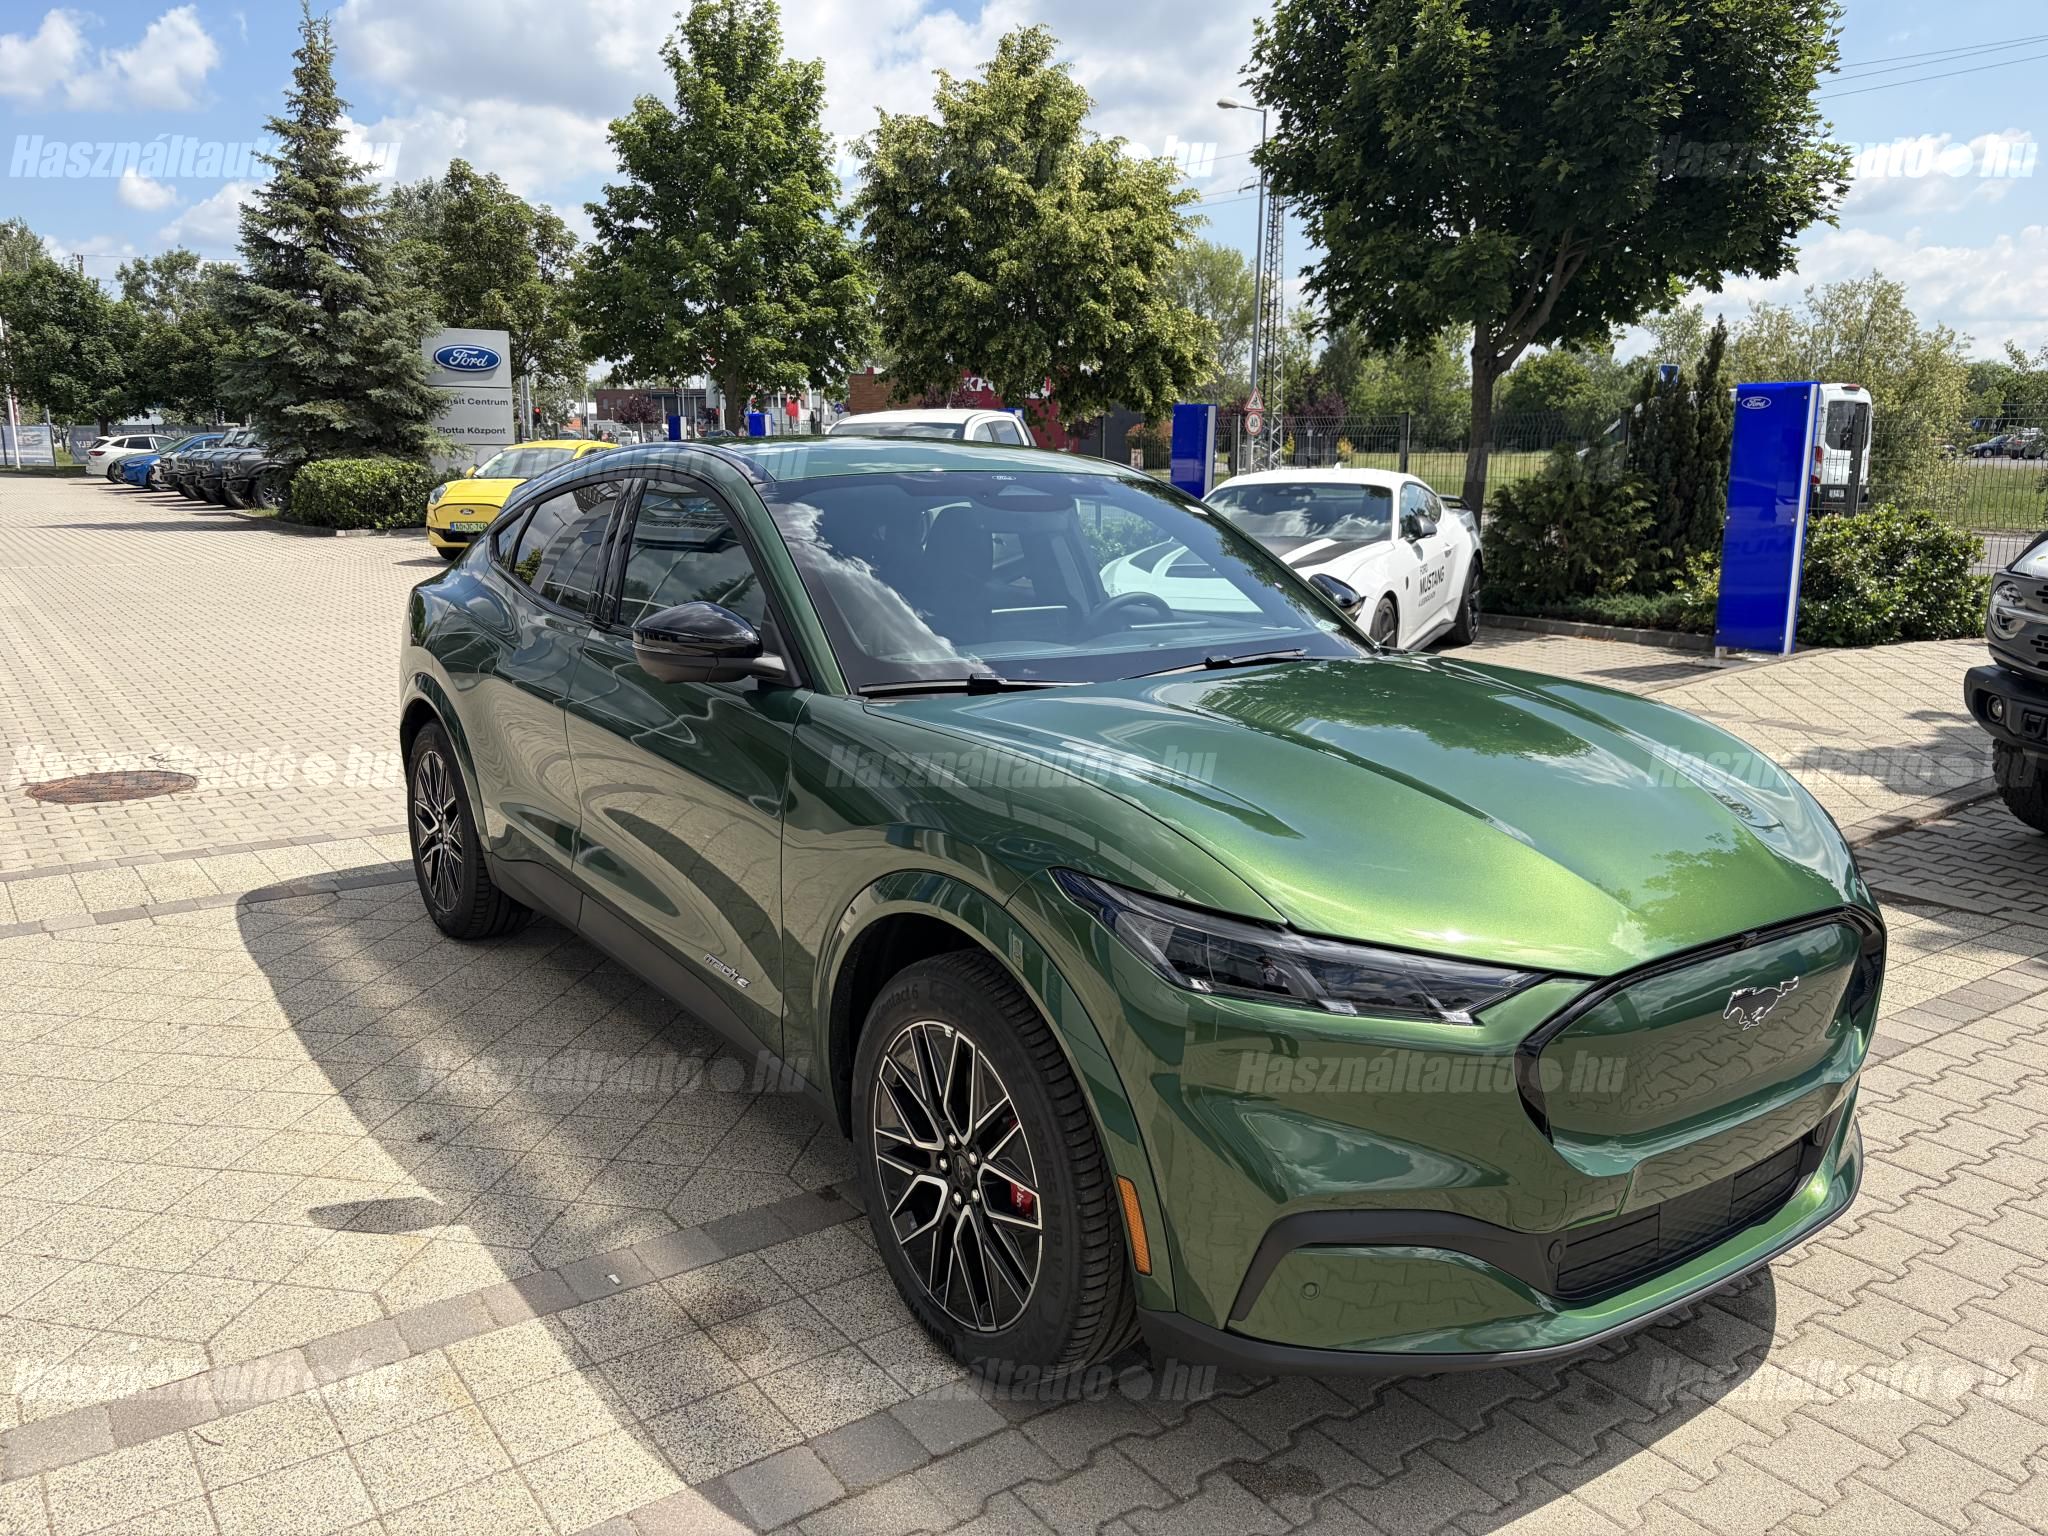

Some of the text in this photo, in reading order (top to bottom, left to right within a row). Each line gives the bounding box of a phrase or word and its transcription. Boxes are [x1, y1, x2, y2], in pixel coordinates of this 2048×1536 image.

[449, 348, 488, 367] Ford
[467, 397, 509, 406] Centrum
[1746, 397, 1766, 408] Ford
[437, 426, 506, 436] Flotta Központ
[1420, 565, 1444, 595] MUSTANG
